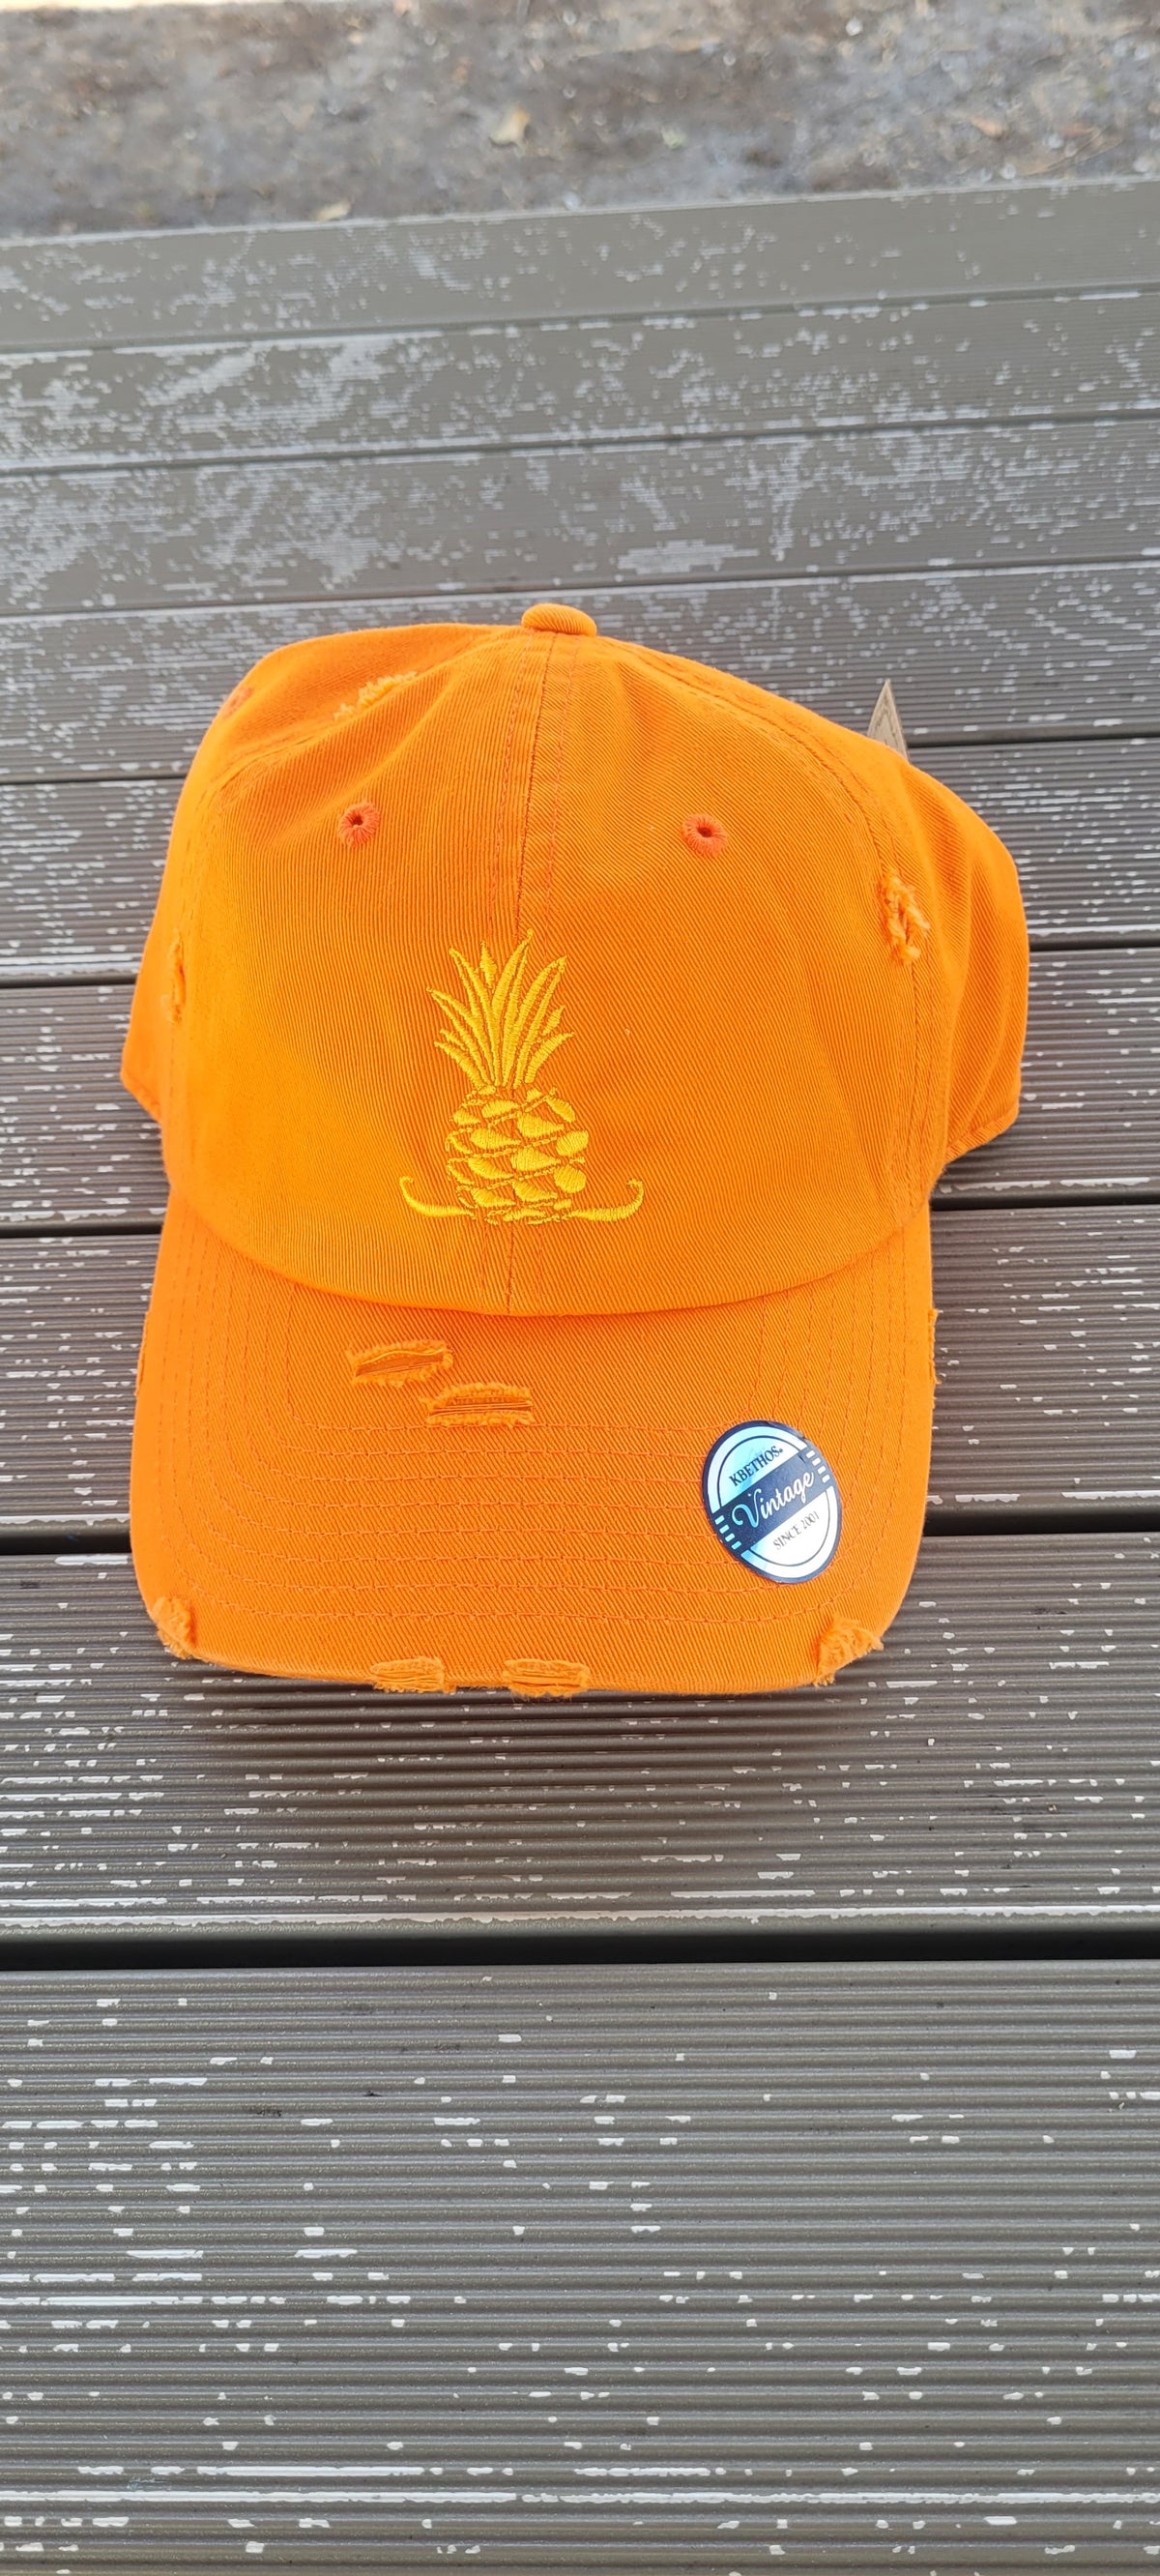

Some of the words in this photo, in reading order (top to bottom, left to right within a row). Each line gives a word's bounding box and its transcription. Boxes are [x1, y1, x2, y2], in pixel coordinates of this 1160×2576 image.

[732, 1471, 814, 1528] Vintage
[772, 1524, 801, 1551] SINCE
[801, 1511, 821, 1530] 2001
